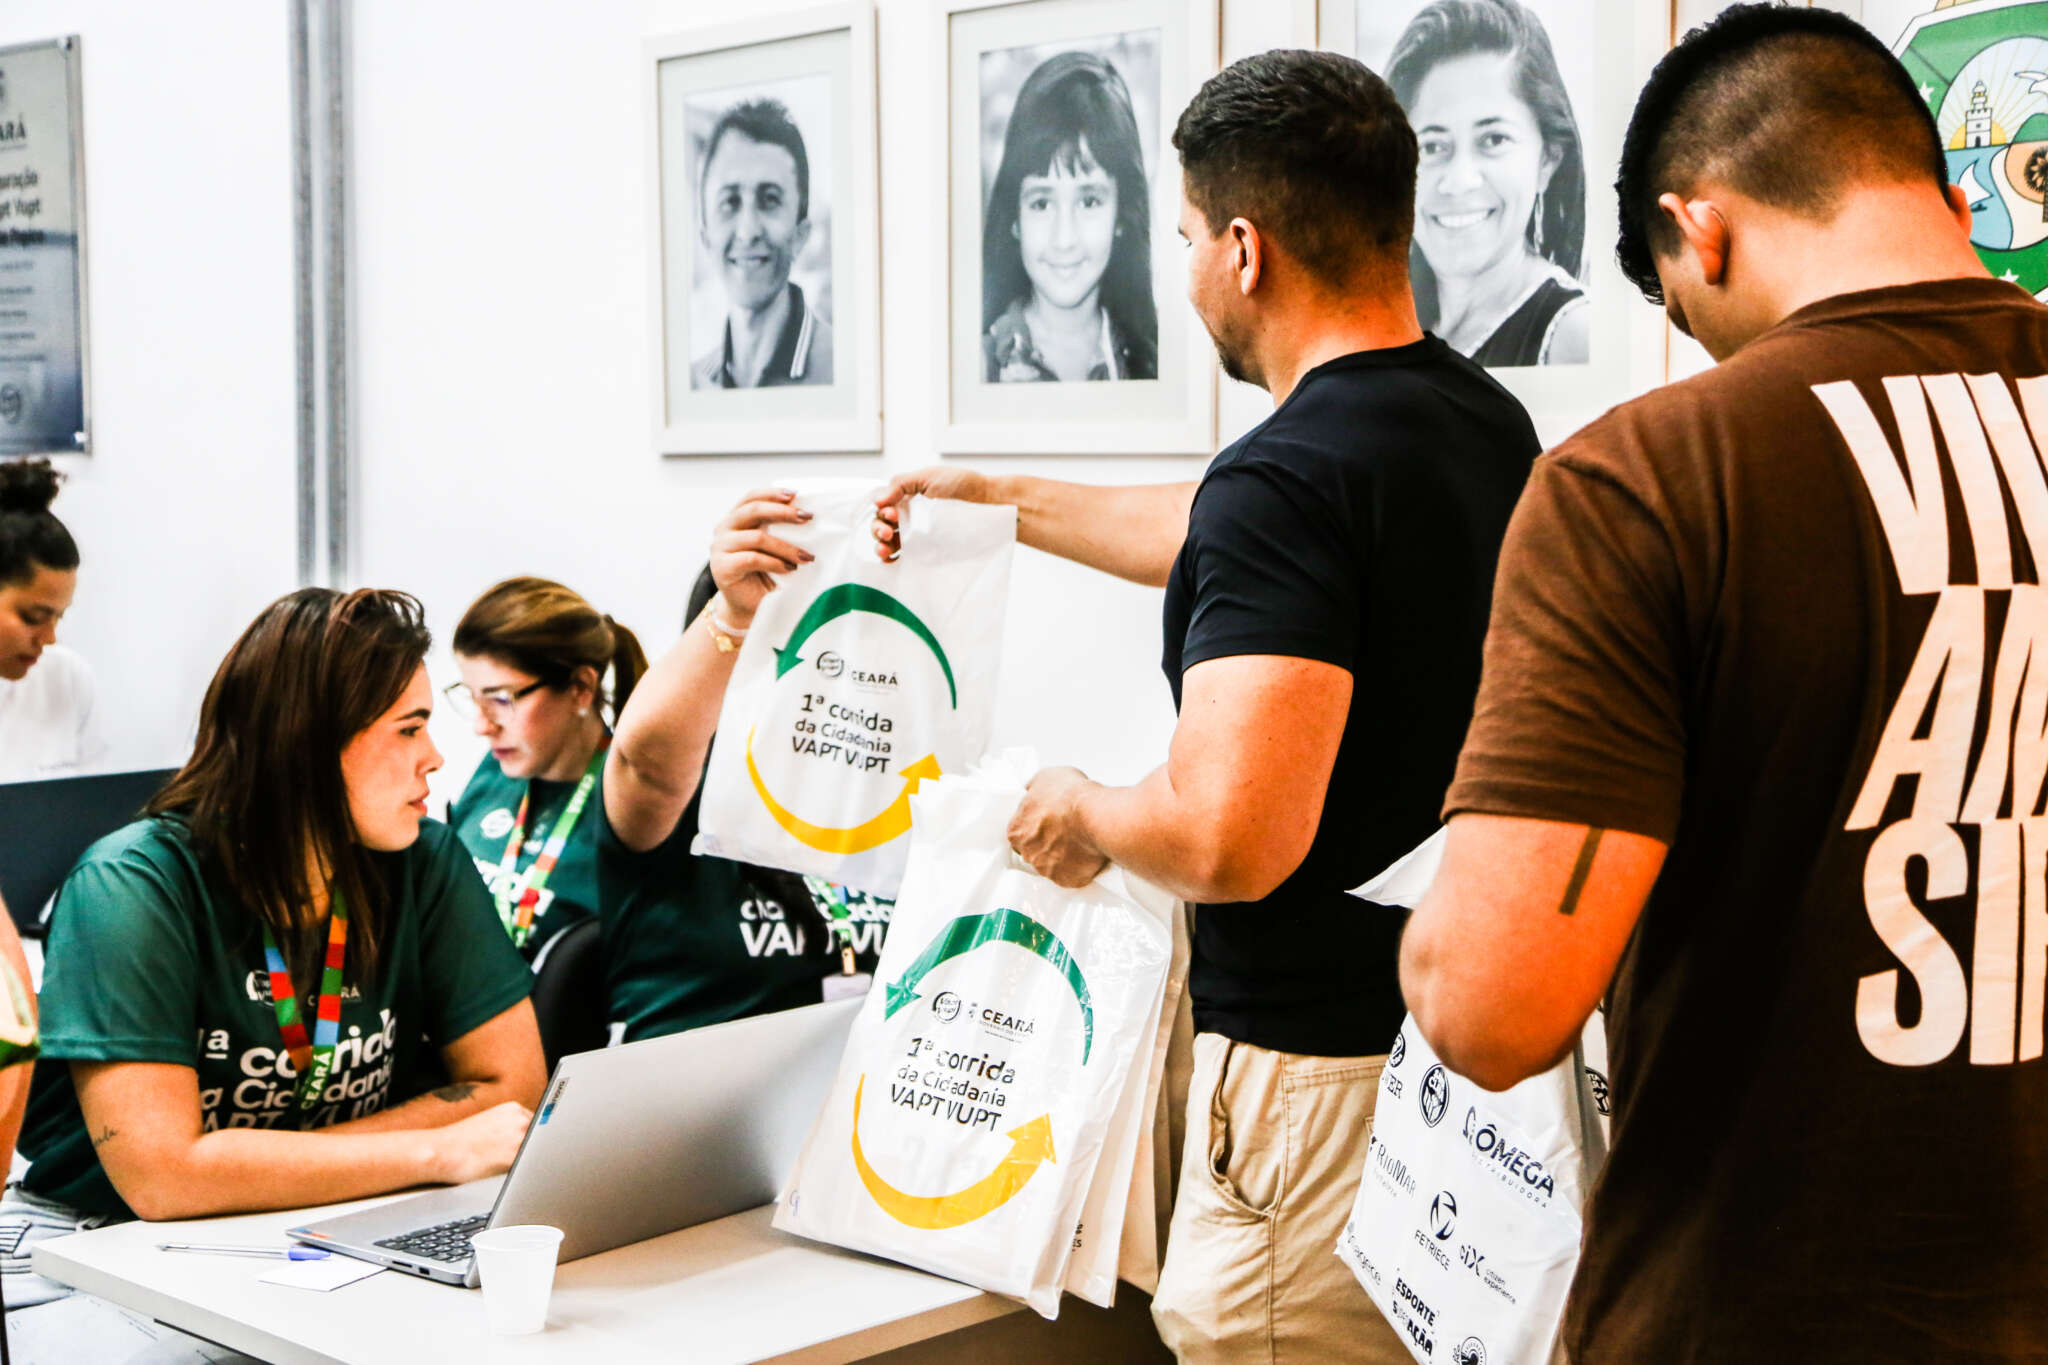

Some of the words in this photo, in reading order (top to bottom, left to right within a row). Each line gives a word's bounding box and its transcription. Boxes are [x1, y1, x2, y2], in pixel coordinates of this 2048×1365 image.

[851, 670, 898, 685] CEARÁ
[794, 718, 817, 734] da
[792, 735, 842, 761] VAPT
[845, 749, 891, 773] VUPT
[982, 1008, 1035, 1034] CEARÁ
[301, 1052, 332, 1110] CEARÁ
[897, 1065, 919, 1082] da
[923, 1071, 1007, 1107] Cidadania
[936, 1050, 1016, 1084] corrida
[890, 1083, 946, 1116] VAPT
[946, 1100, 1002, 1132] VUPT
[1475, 1123, 1554, 1199] ÔMEGA
[1415, 1229, 1450, 1272] FETRIECE
[1395, 1277, 1436, 1327] ESPORTE
